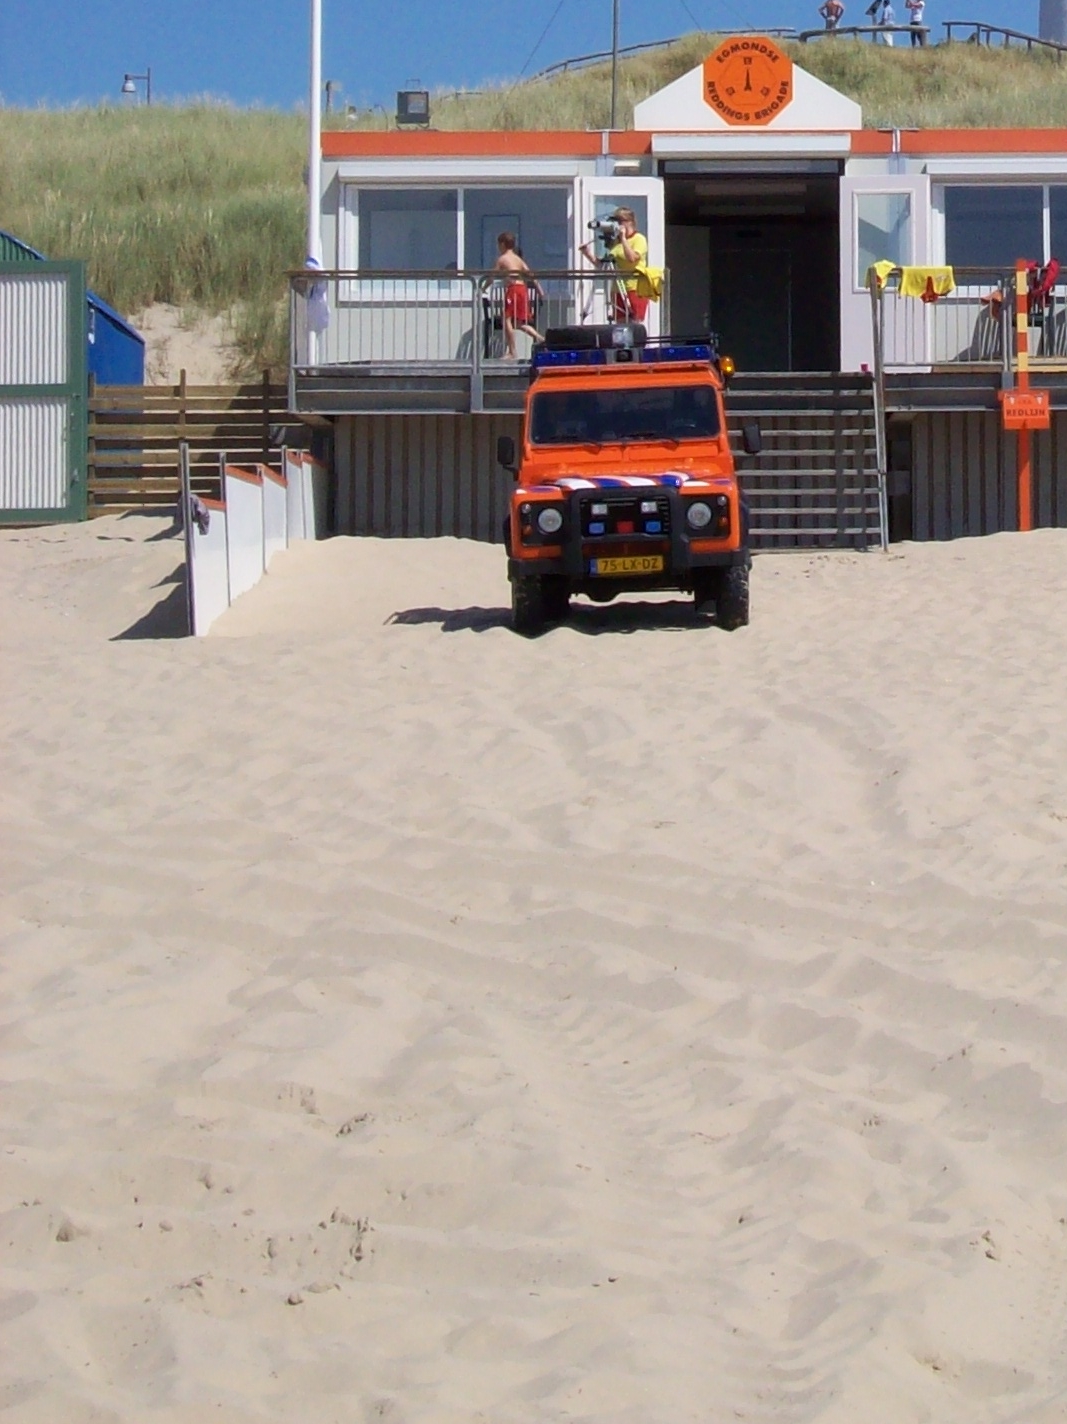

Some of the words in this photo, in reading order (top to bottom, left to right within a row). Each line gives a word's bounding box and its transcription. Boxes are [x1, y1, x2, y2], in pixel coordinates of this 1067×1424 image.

[716, 41, 780, 64] EGMONDSE
[707, 80, 751, 121] REDDINGS
[754, 80, 790, 120] BRIGADE
[601, 558, 659, 572] 75-LX-DZ
